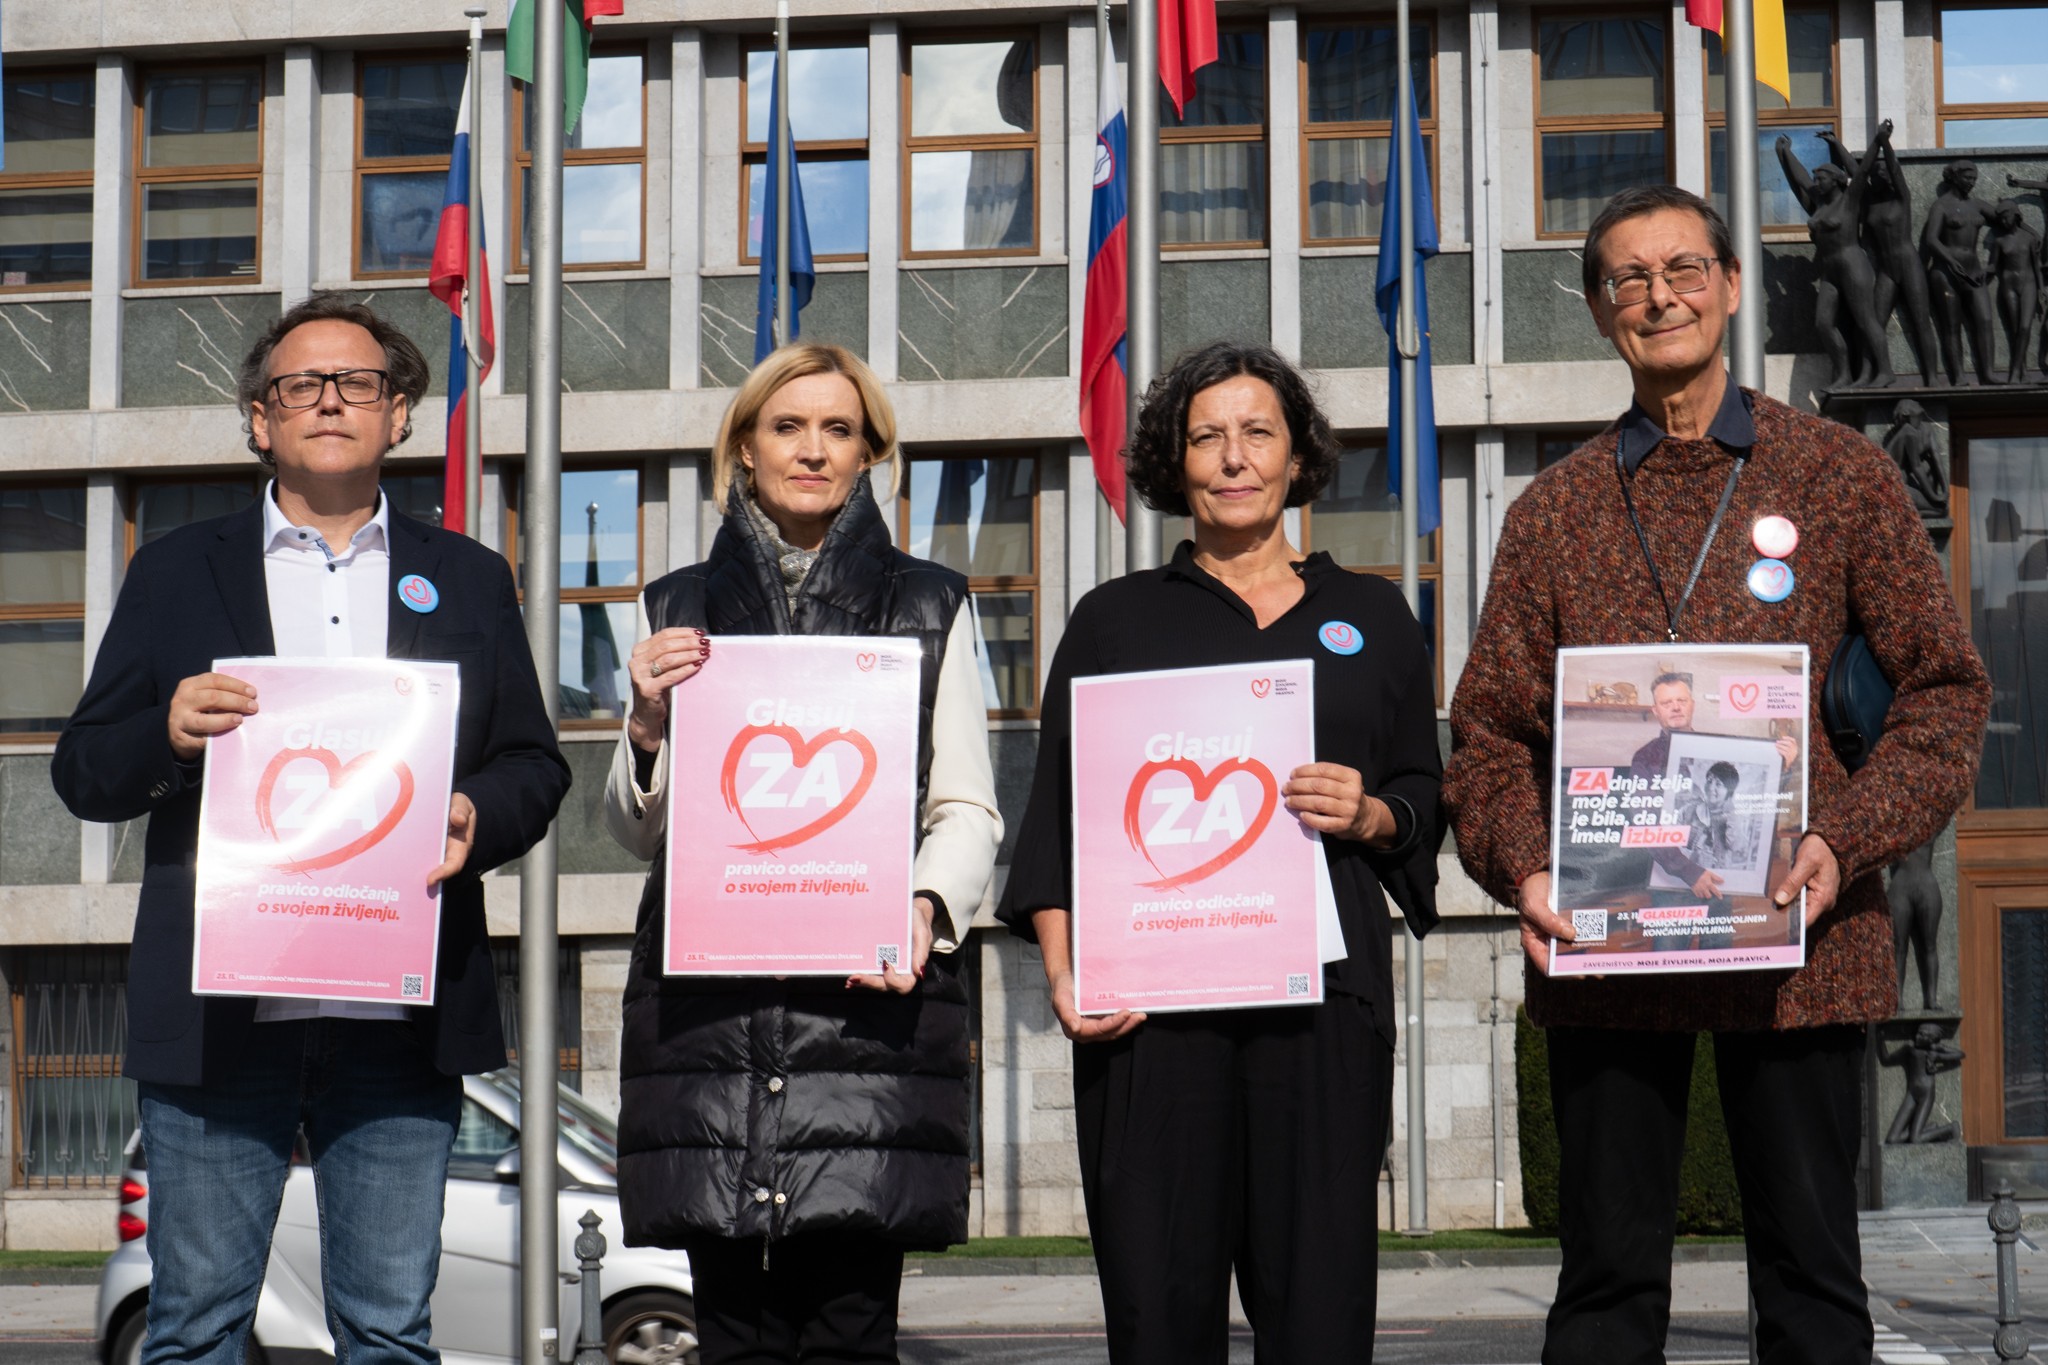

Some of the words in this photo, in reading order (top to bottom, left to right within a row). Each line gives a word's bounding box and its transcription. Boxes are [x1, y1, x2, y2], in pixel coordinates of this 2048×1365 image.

[746, 698, 856, 734] Glasuj
[1145, 725, 1254, 764] Glasuj
[741, 752, 843, 808] ZA
[1573, 771, 1648, 794] ZAdnja
[1650, 774, 1693, 793] želja
[1572, 793, 1618, 812] moje
[1620, 792, 1664, 808] žene
[1145, 783, 1247, 846] ZA
[1569, 811, 1589, 830] je
[1591, 810, 1629, 827] bila,
[1633, 810, 1657, 825] da
[1660, 809, 1679, 825] bi
[1571, 827, 1620, 844] imela
[1626, 828, 1686, 844] izbiro.
[725, 861, 786, 879] pravico
[788, 861, 868, 878] odločanja
[257, 882, 320, 898] pravico
[322, 884, 400, 904] odločanja
[725, 882, 736, 893] o
[739, 880, 796, 896] svojem
[799, 879, 869, 896] življenju.
[257, 903, 269, 913] o
[271, 901, 330, 917] svojem
[332, 902, 400, 923] življenju.
[1132, 897, 1193, 917] pravico
[1195, 891, 1275, 911] odločanja
[1643, 909, 1686, 920] GLASUJ
[1687, 908, 1703, 918] ZA
[1132, 920, 1144, 931] o
[1147, 915, 1204, 932] svojem
[1207, 910, 1278, 929] življenju.
[1733, 955, 1771, 963] PRAVICA
